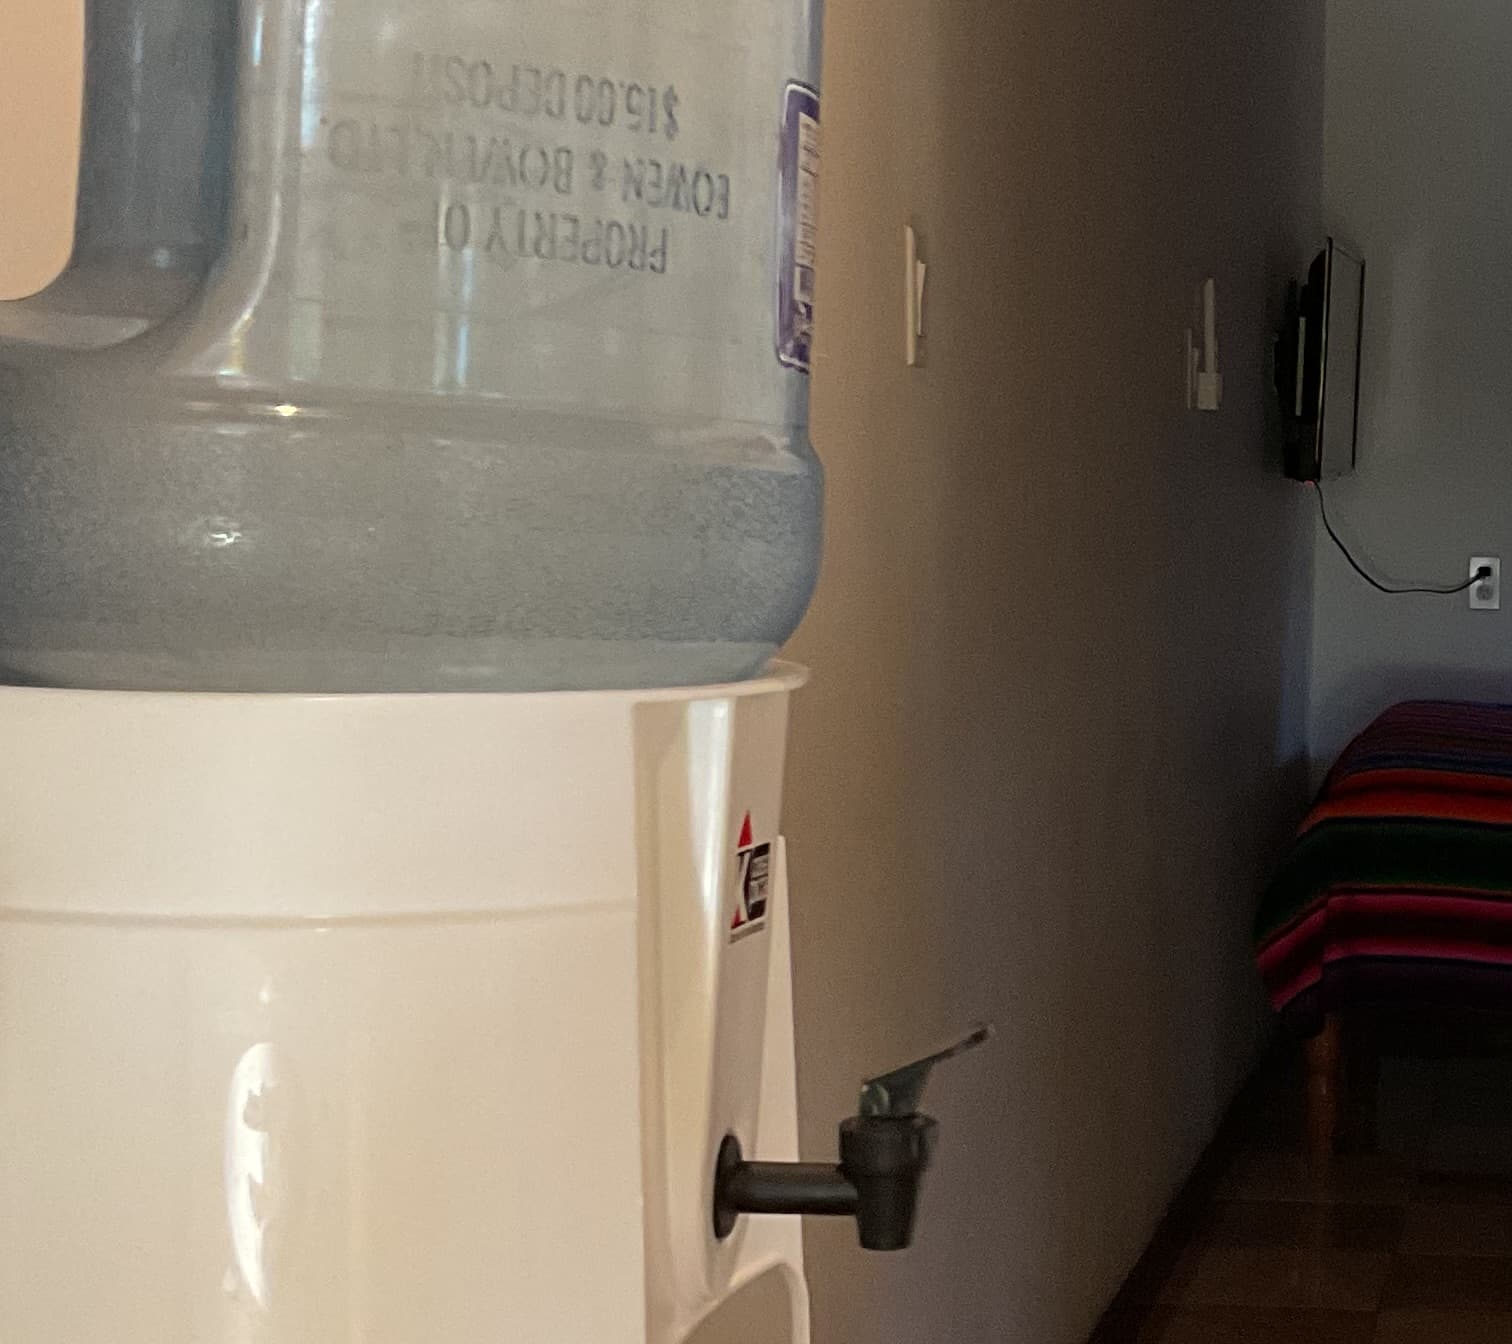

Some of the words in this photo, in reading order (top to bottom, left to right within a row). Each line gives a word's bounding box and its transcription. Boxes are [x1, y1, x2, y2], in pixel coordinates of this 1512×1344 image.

[573, 73, 681, 143] $15.00
[590, 149, 615, 195] &
[486, 206, 669, 275] PROPERTY
